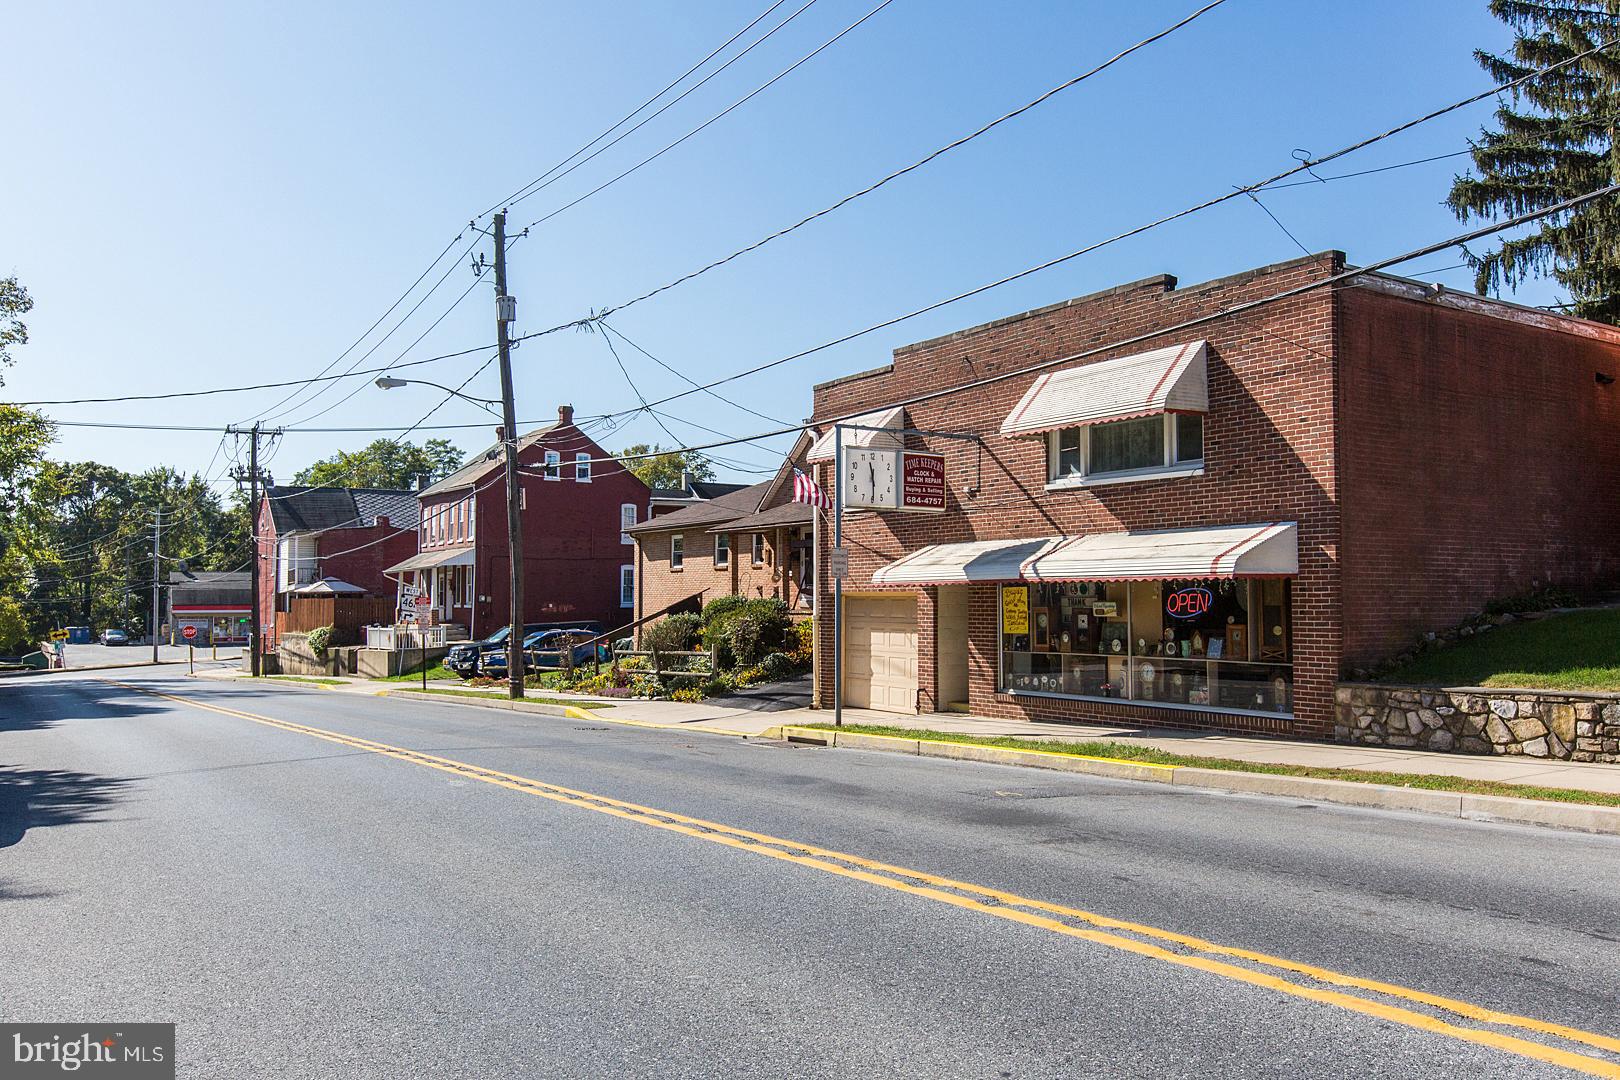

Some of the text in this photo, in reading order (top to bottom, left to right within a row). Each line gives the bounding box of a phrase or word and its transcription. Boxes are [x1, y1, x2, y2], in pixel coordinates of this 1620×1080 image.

[870, 452, 876, 460] 12
[852, 462, 858, 470] 10
[905, 458, 944, 472] TIME KEEPERS
[850, 472, 854, 480] 9
[854, 484, 858, 492] 8
[870, 496, 874, 504] 6
[906, 496, 942, 504] 684-4757
[1167, 593, 1209, 613] OPEN
